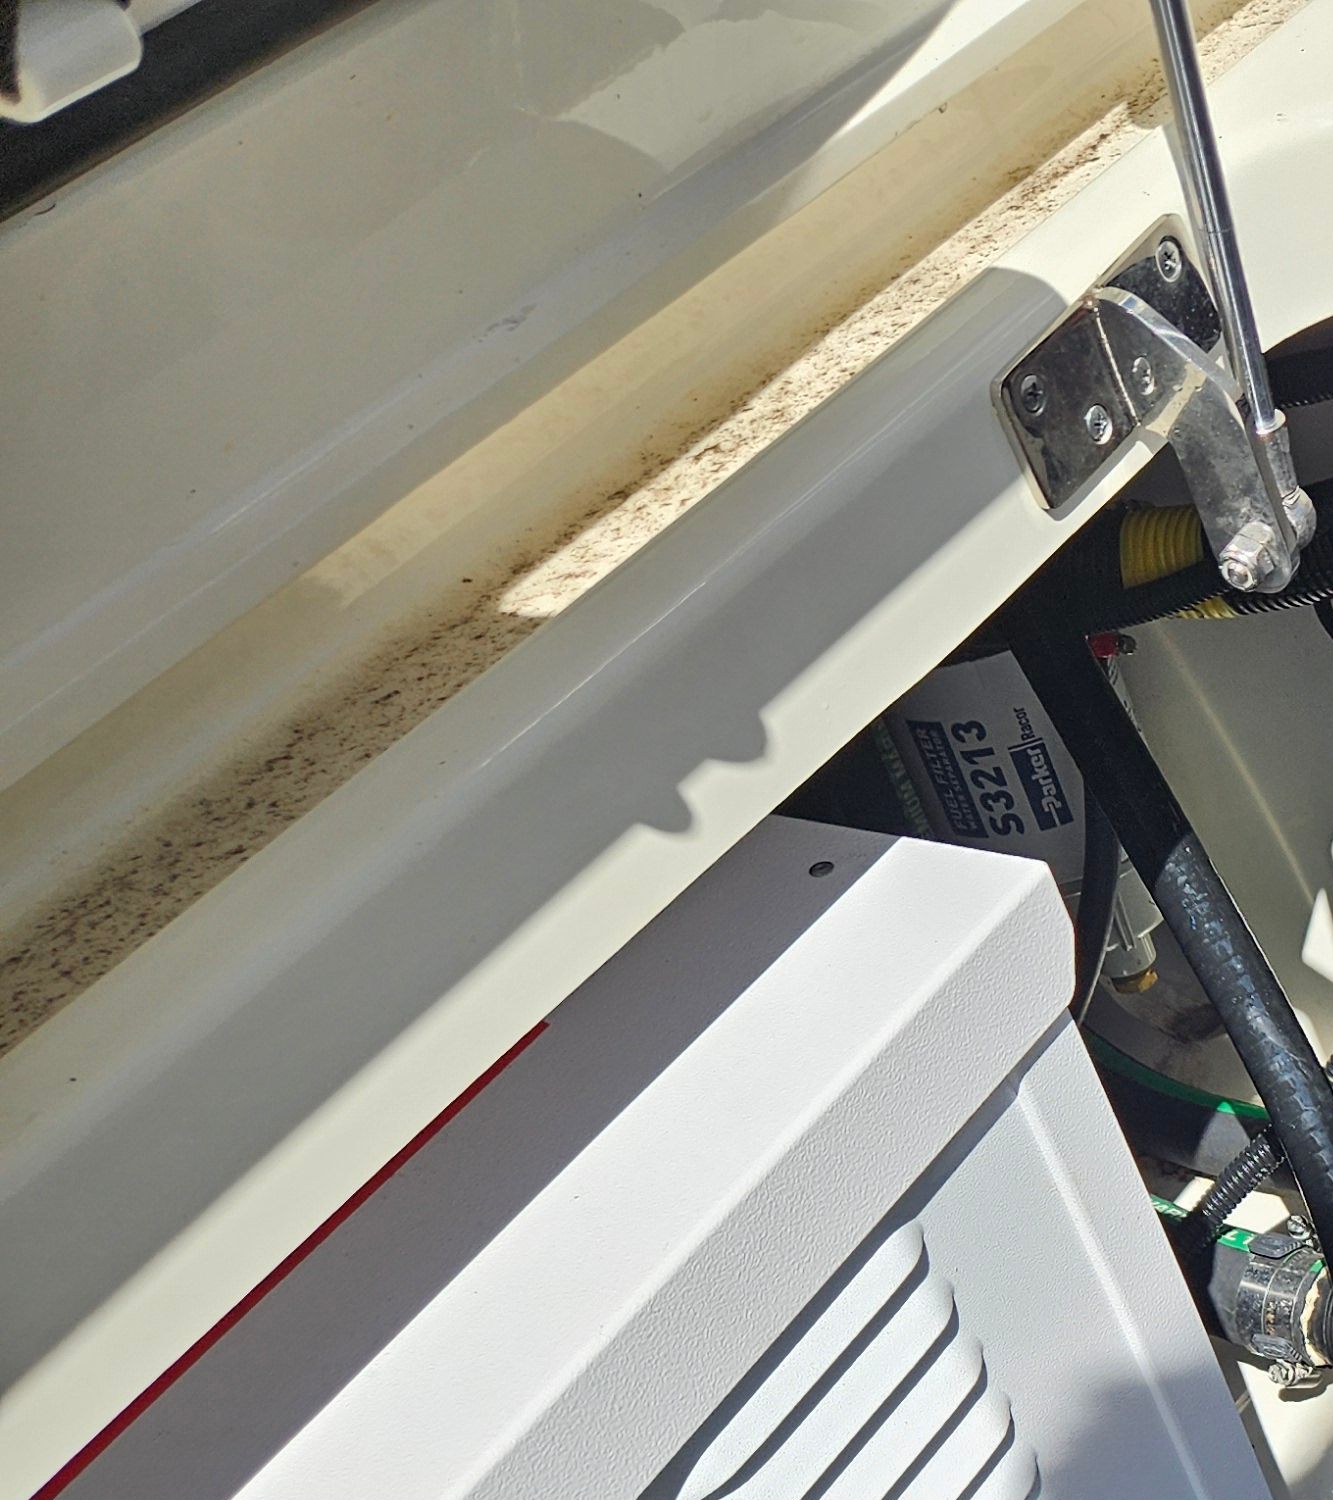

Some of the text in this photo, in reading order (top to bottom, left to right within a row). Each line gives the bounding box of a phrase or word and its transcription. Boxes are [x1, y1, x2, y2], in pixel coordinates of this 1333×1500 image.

[915, 726, 967, 830] FUEL FILTER
[949, 716, 1026, 840] S3213
[1012, 705, 1061, 812] Parker Racor
